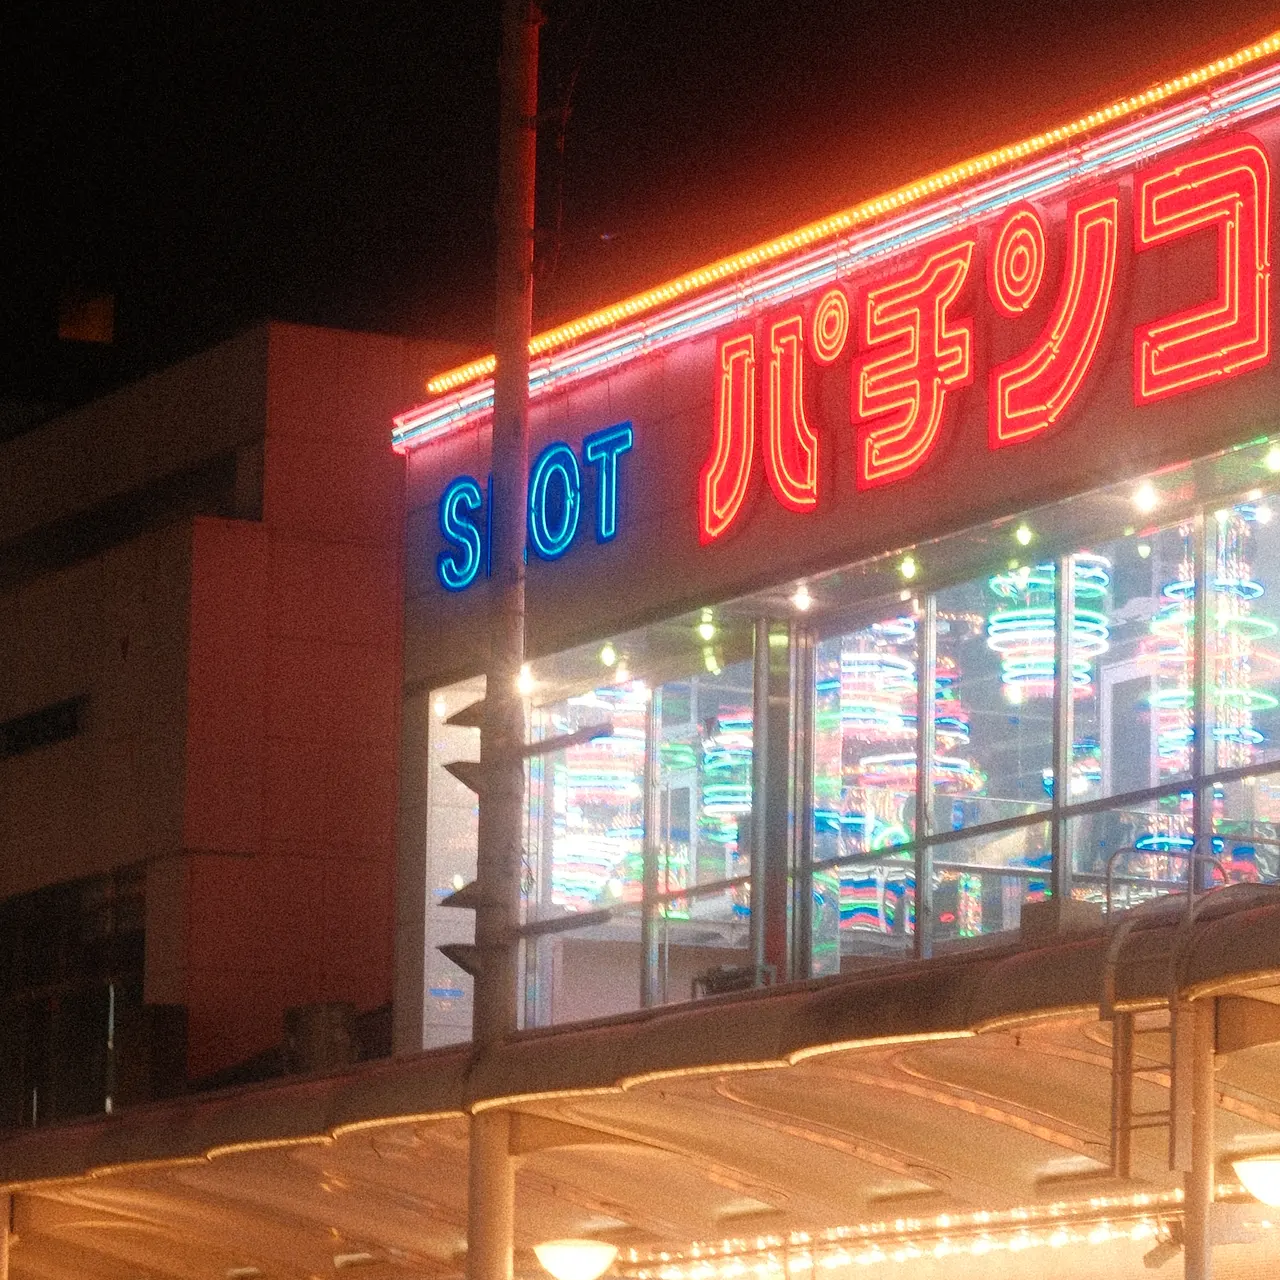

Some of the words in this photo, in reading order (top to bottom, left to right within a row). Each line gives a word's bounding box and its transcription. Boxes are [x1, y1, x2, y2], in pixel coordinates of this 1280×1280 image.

[698, 131, 1272, 546] パチンコ
[437, 421, 633, 592] SOT
